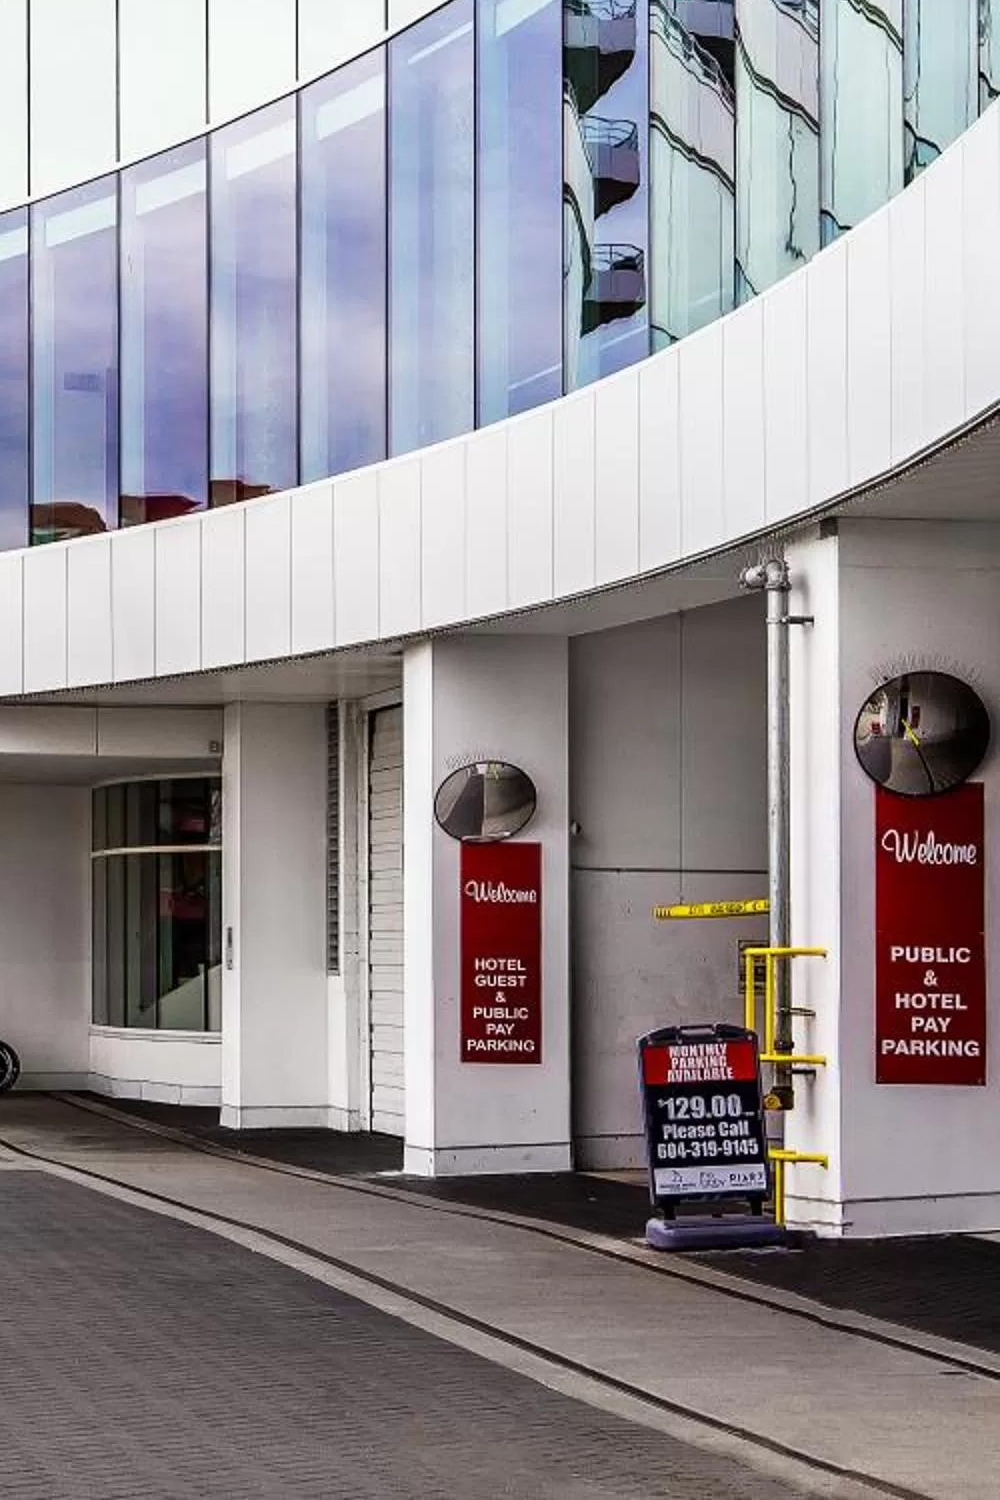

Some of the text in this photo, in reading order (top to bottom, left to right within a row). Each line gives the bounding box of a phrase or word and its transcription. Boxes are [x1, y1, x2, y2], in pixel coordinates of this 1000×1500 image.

[882, 829, 977, 865] Welcome
[464, 880, 537, 903] Welcome
[891, 946, 971, 963] PUBLIC
[474, 957, 526, 971] HOTEL
[474, 974, 527, 988] GUEST
[923, 969, 938, 987] &
[495, 991, 507, 1003] &
[895, 993, 968, 1010] HOTEL
[472, 1006, 529, 1020] PUBLIC
[485, 1023, 515, 1035] PAY
[911, 1016, 952, 1033] PAY
[466, 1039, 535, 1052] PARKING
[668, 1043, 728, 1058] MONTHLY
[881, 1039, 980, 1057] PARKING
[671, 1056, 727, 1069] PARKING
[667, 1067, 734, 1082] AVAILABLE
[662, 1120, 749, 1139] Please Call
[657, 1137, 759, 1159] 604-319-9145
